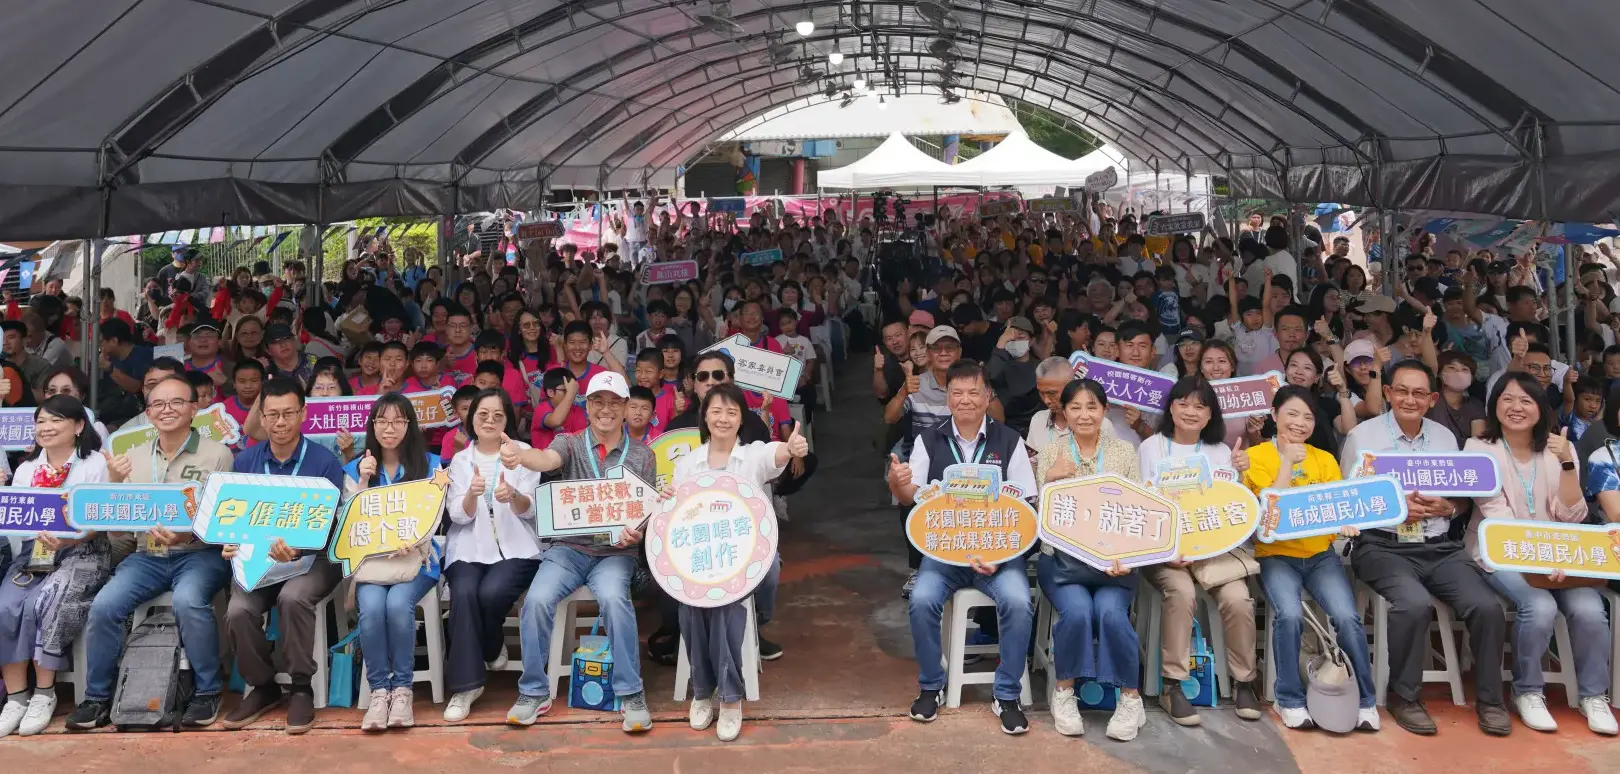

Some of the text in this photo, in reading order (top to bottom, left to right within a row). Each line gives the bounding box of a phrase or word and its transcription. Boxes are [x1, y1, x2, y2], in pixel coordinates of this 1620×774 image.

[738, 358, 783, 377] 客家委員會
[309, 412, 371, 431] 大肚國民
[360, 489, 407, 518] 唱出
[559, 481, 632, 505] 客語校歌
[84, 503, 179, 523] 關東國民小學
[585, 500, 645, 525] 當好聽
[924, 508, 1021, 530] 校園唱客創作
[1288, 496, 1387, 528] 僑成國民小學
[671, 516, 752, 549] 校園唱客
[925, 531, 1022, 551] 聯合成果發表會
[690, 543, 738, 573] 創作
[1502, 540, 1608, 567] 東勢國民小學
